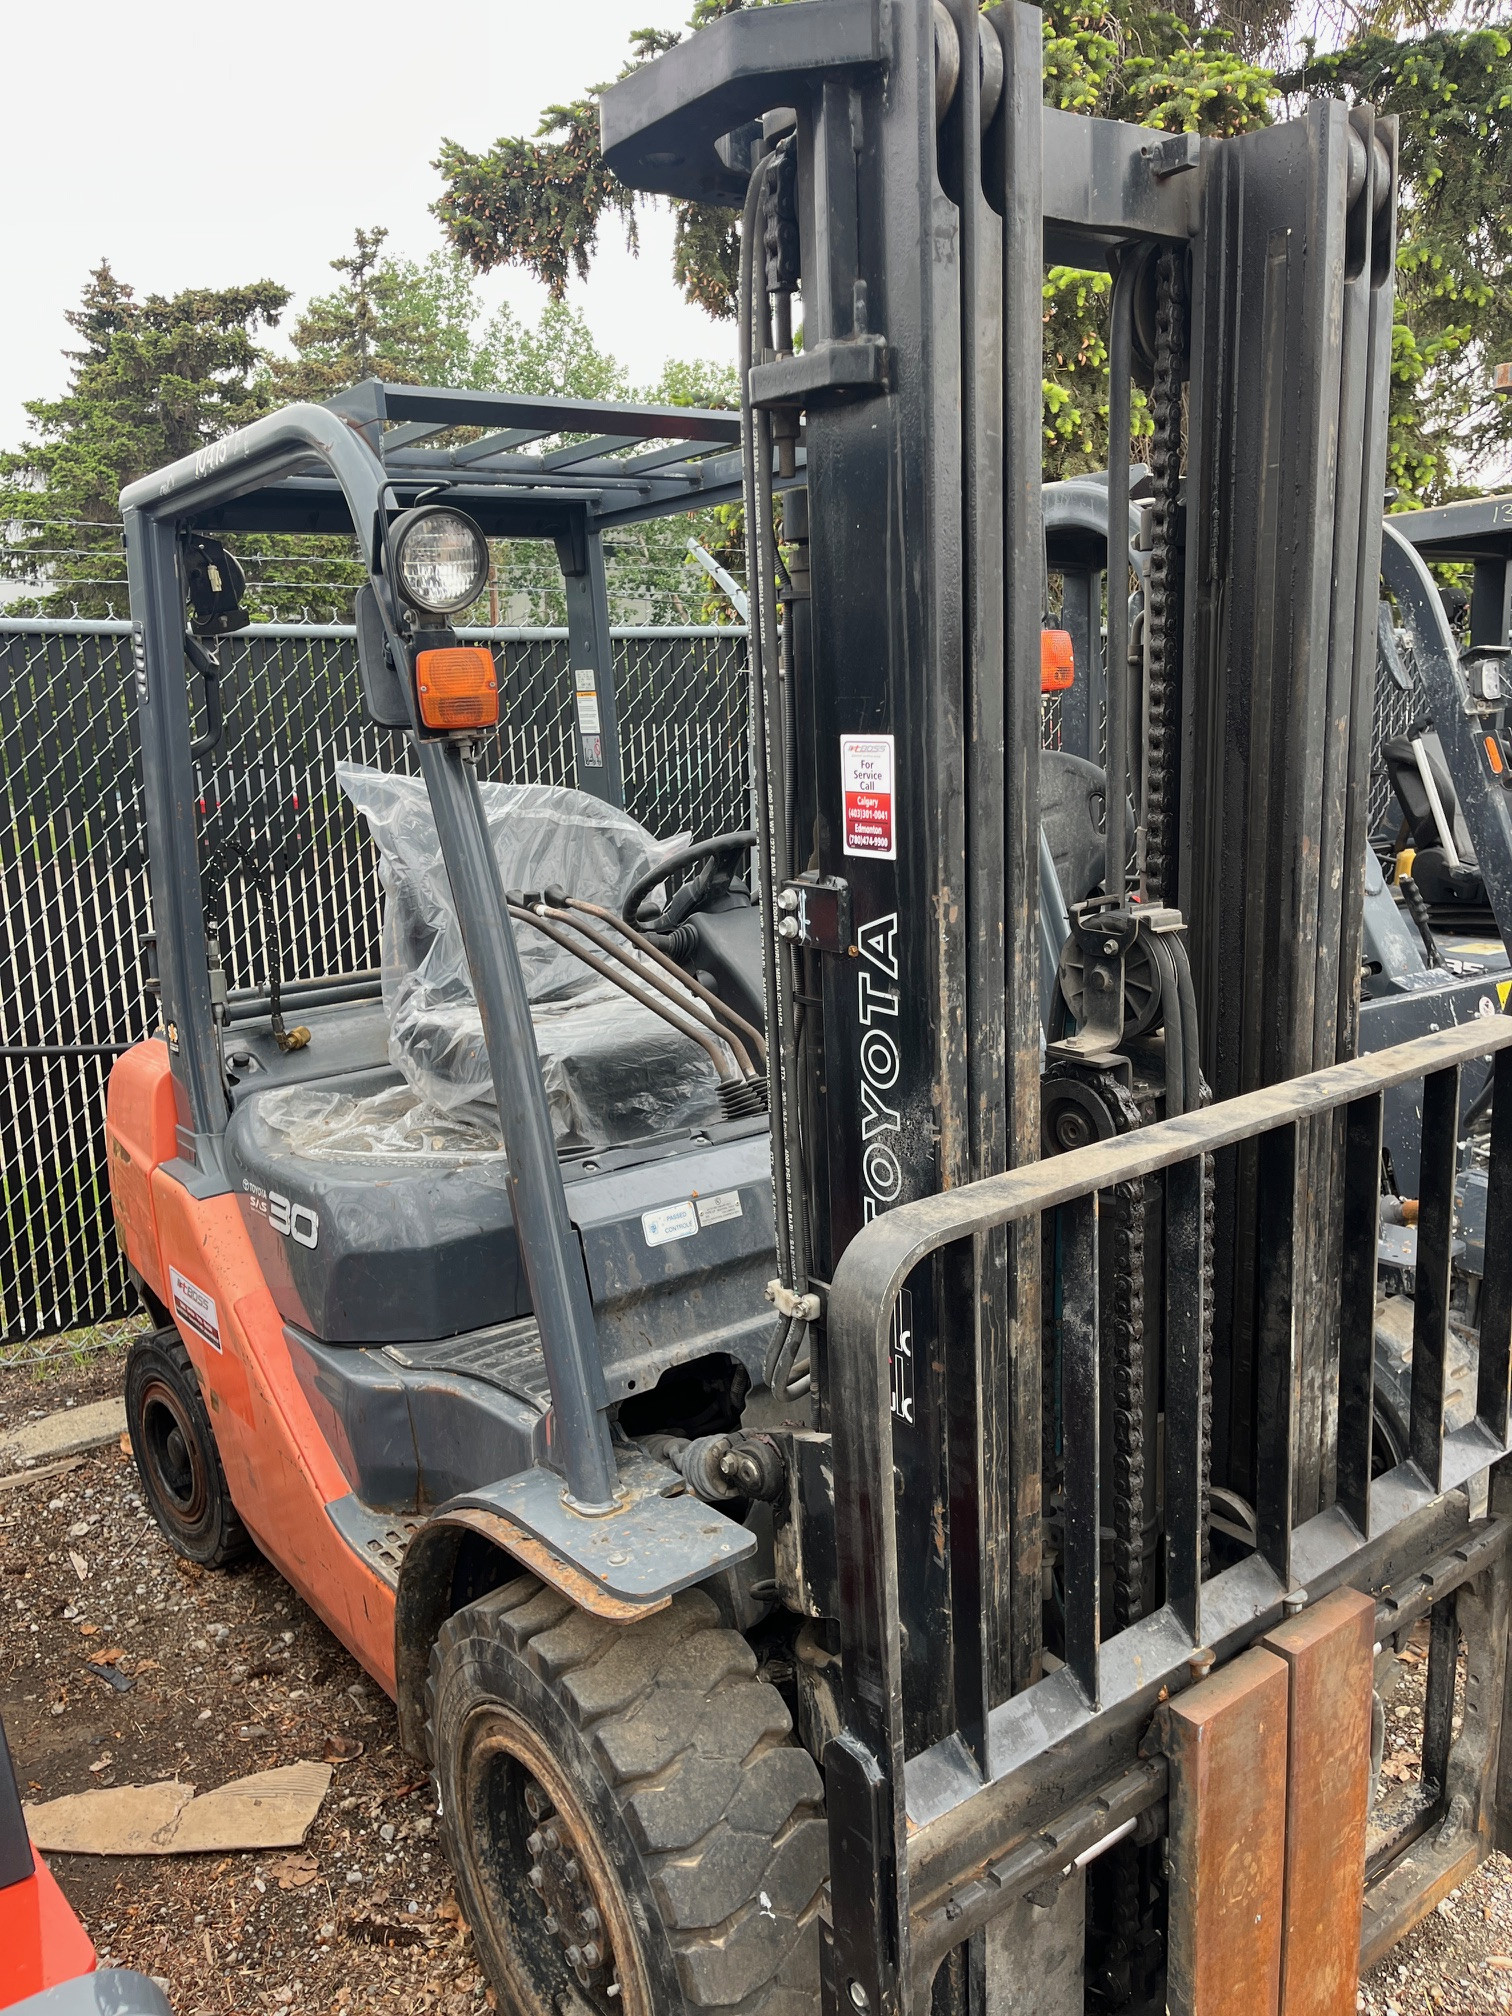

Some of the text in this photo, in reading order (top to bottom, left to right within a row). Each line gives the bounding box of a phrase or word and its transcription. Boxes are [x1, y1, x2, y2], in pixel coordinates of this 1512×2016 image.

[861, 760, 874, 769] For
[853, 770, 882, 780] Service
[860, 781, 875, 791] Call
[857, 796, 879, 809] Calgary
[854, 823, 882, 835] Edmonton
[249, 1182, 268, 1200] TOYOTA
[268, 1190, 319, 1250] 30
[666, 1211, 687, 1221] PASSED
